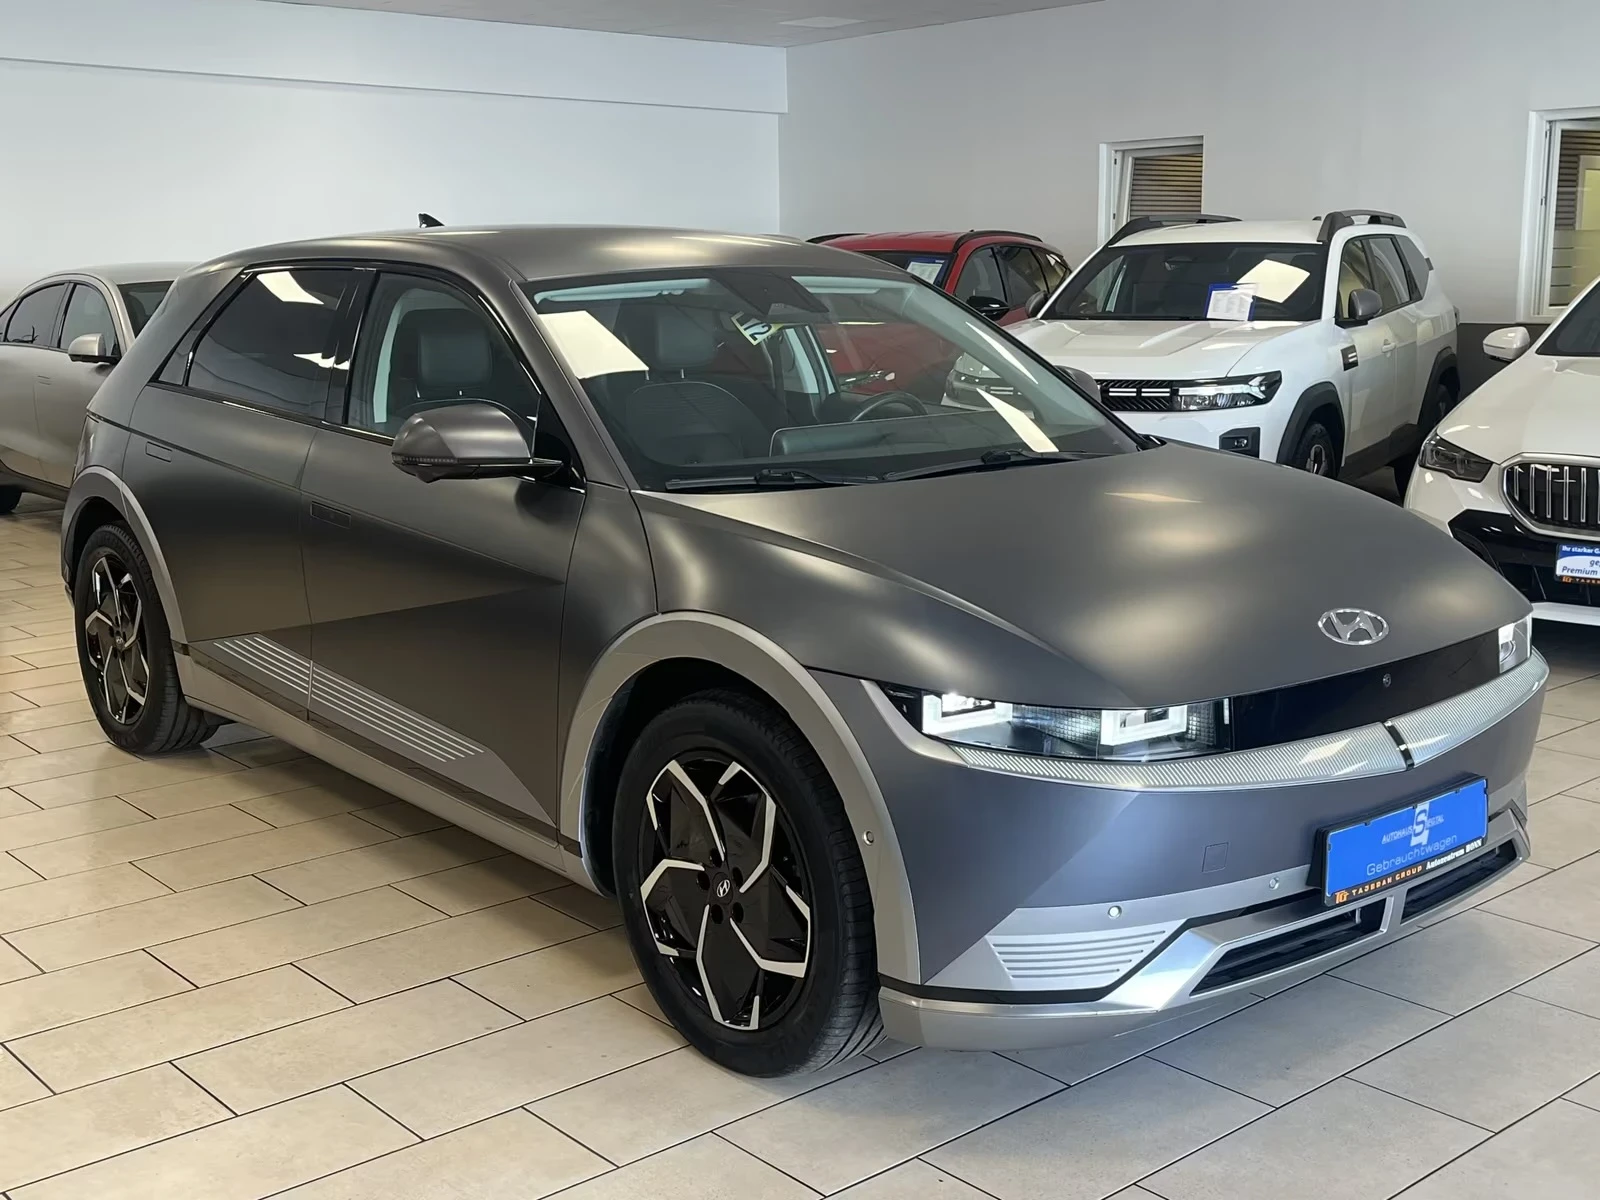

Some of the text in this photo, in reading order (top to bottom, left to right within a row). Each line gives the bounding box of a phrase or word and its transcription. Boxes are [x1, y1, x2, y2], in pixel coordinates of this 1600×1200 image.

[1562, 566, 1598, 575] Premium
[1381, 825, 1413, 845] AUTOHAUS
[1366, 834, 1457, 876] Gebrauchtwagen
[1395, 865, 1422, 881] GROUP
[1426, 848, 1465, 870] Autozentrum
